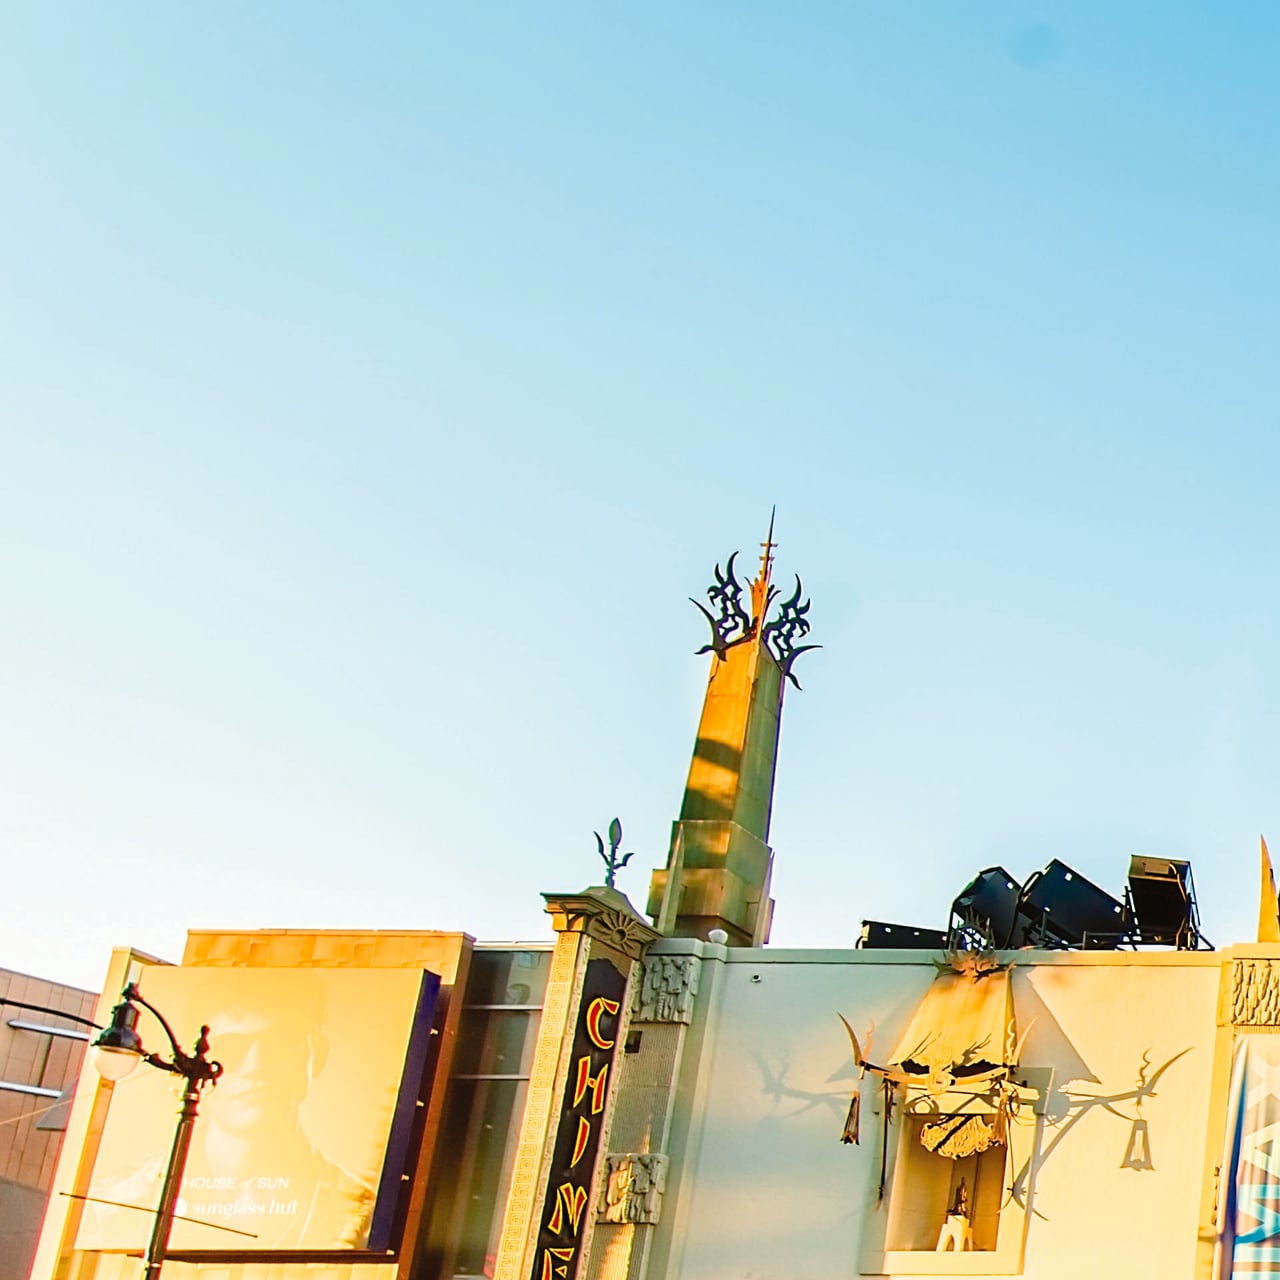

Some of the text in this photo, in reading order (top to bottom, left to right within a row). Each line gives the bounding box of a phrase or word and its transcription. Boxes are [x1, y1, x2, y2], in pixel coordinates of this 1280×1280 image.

[183, 1176, 236, 1189] HOUSE
[256, 1176, 289, 1189] SUN
[191, 1198, 298, 1217] sunglass hut
